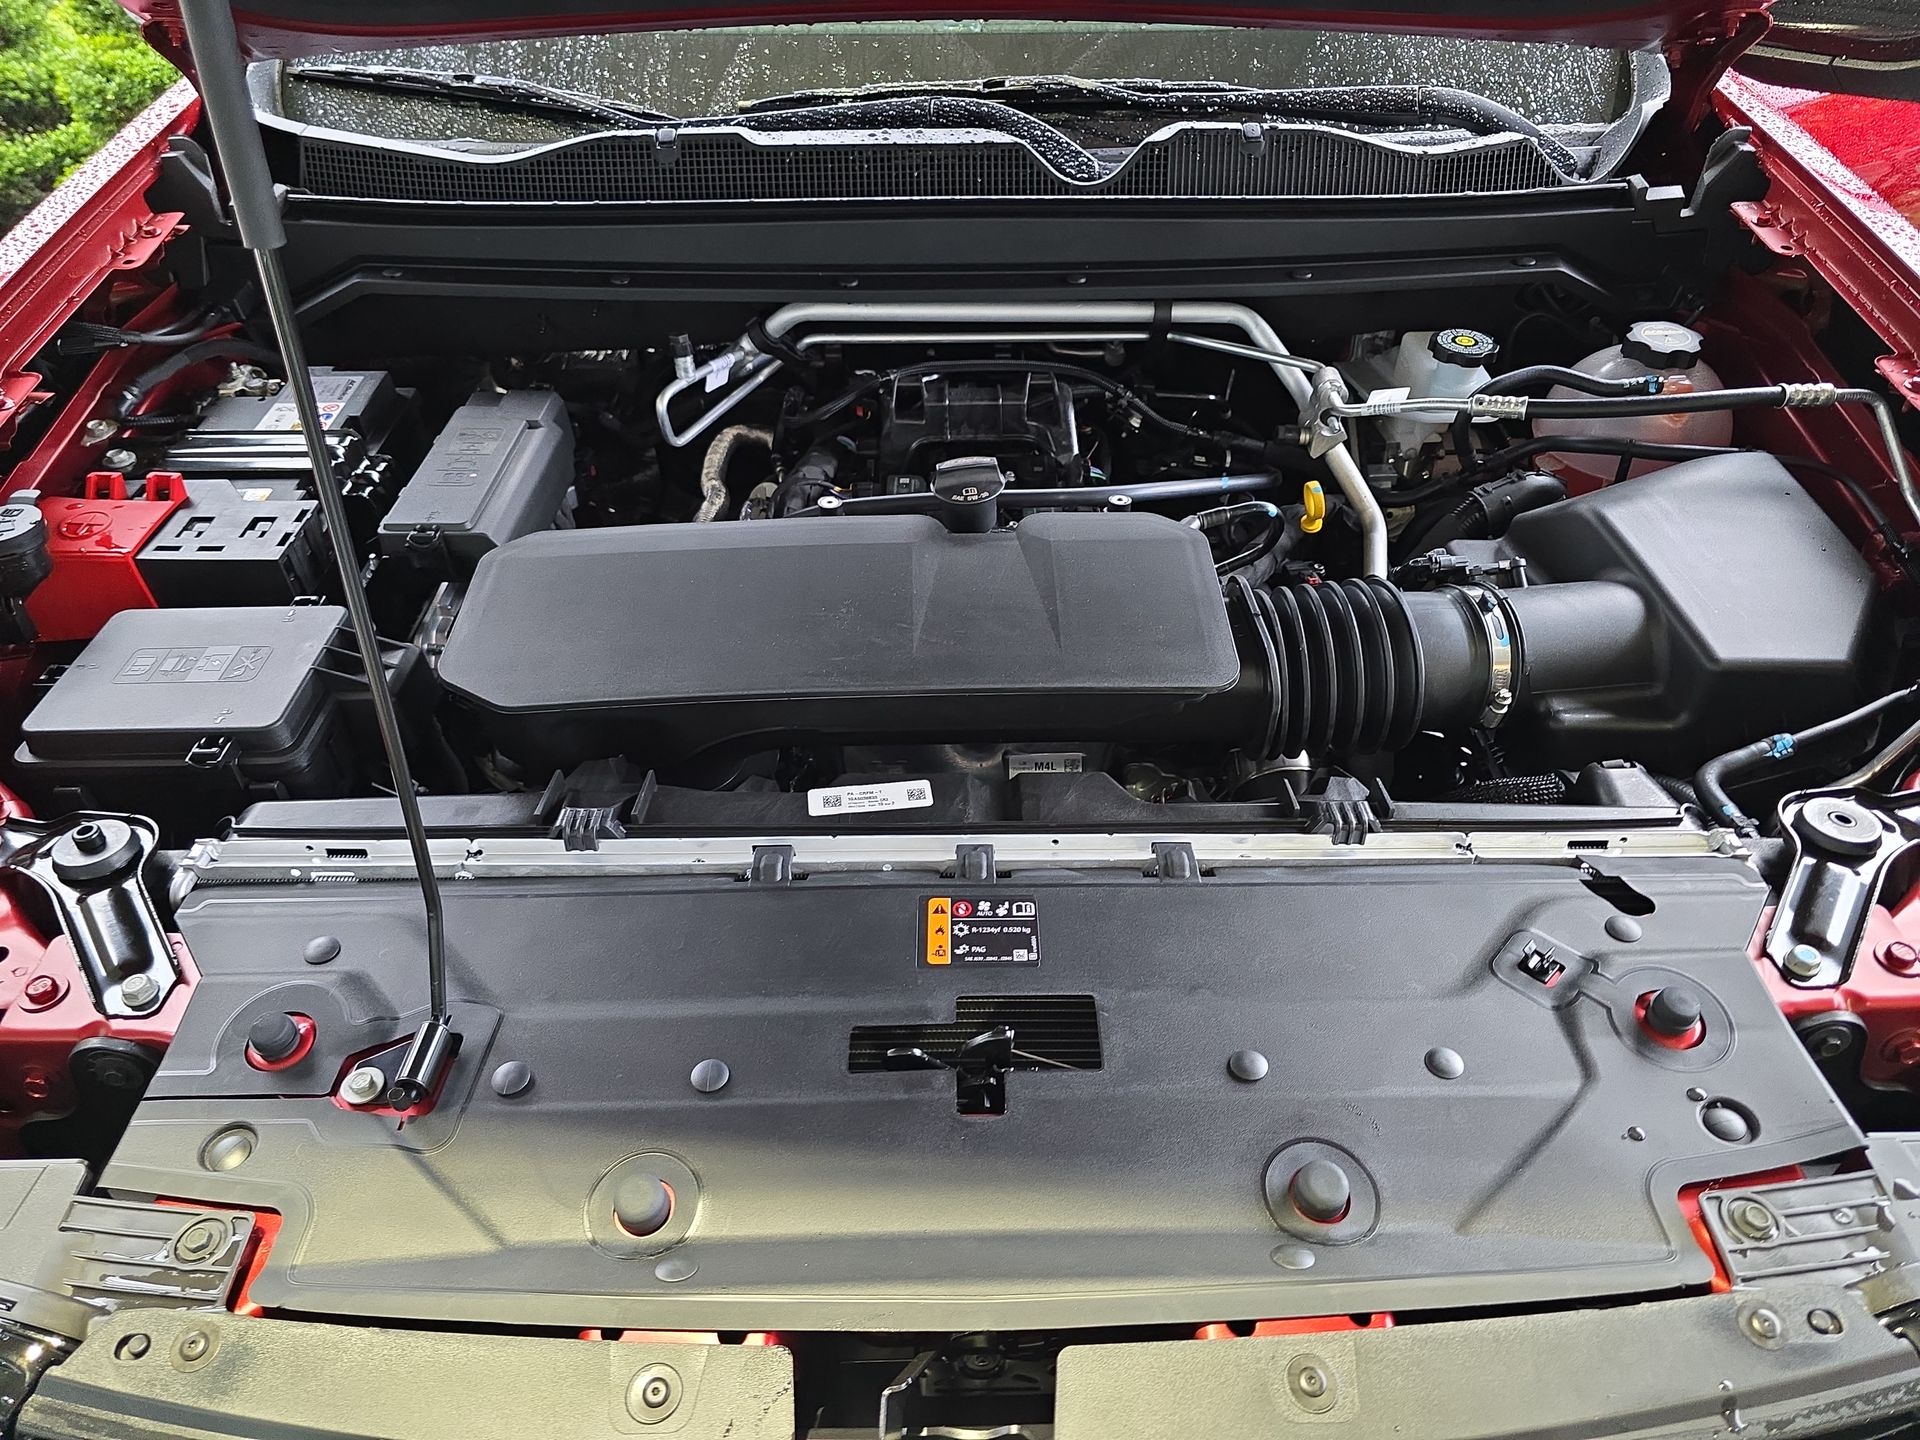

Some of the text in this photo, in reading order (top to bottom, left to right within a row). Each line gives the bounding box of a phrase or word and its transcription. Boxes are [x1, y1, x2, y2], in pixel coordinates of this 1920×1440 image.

[1034, 761, 1057, 771] M4L
[971, 926, 1001, 934] R-1234yf
[1022, 926, 1032, 934] kg
